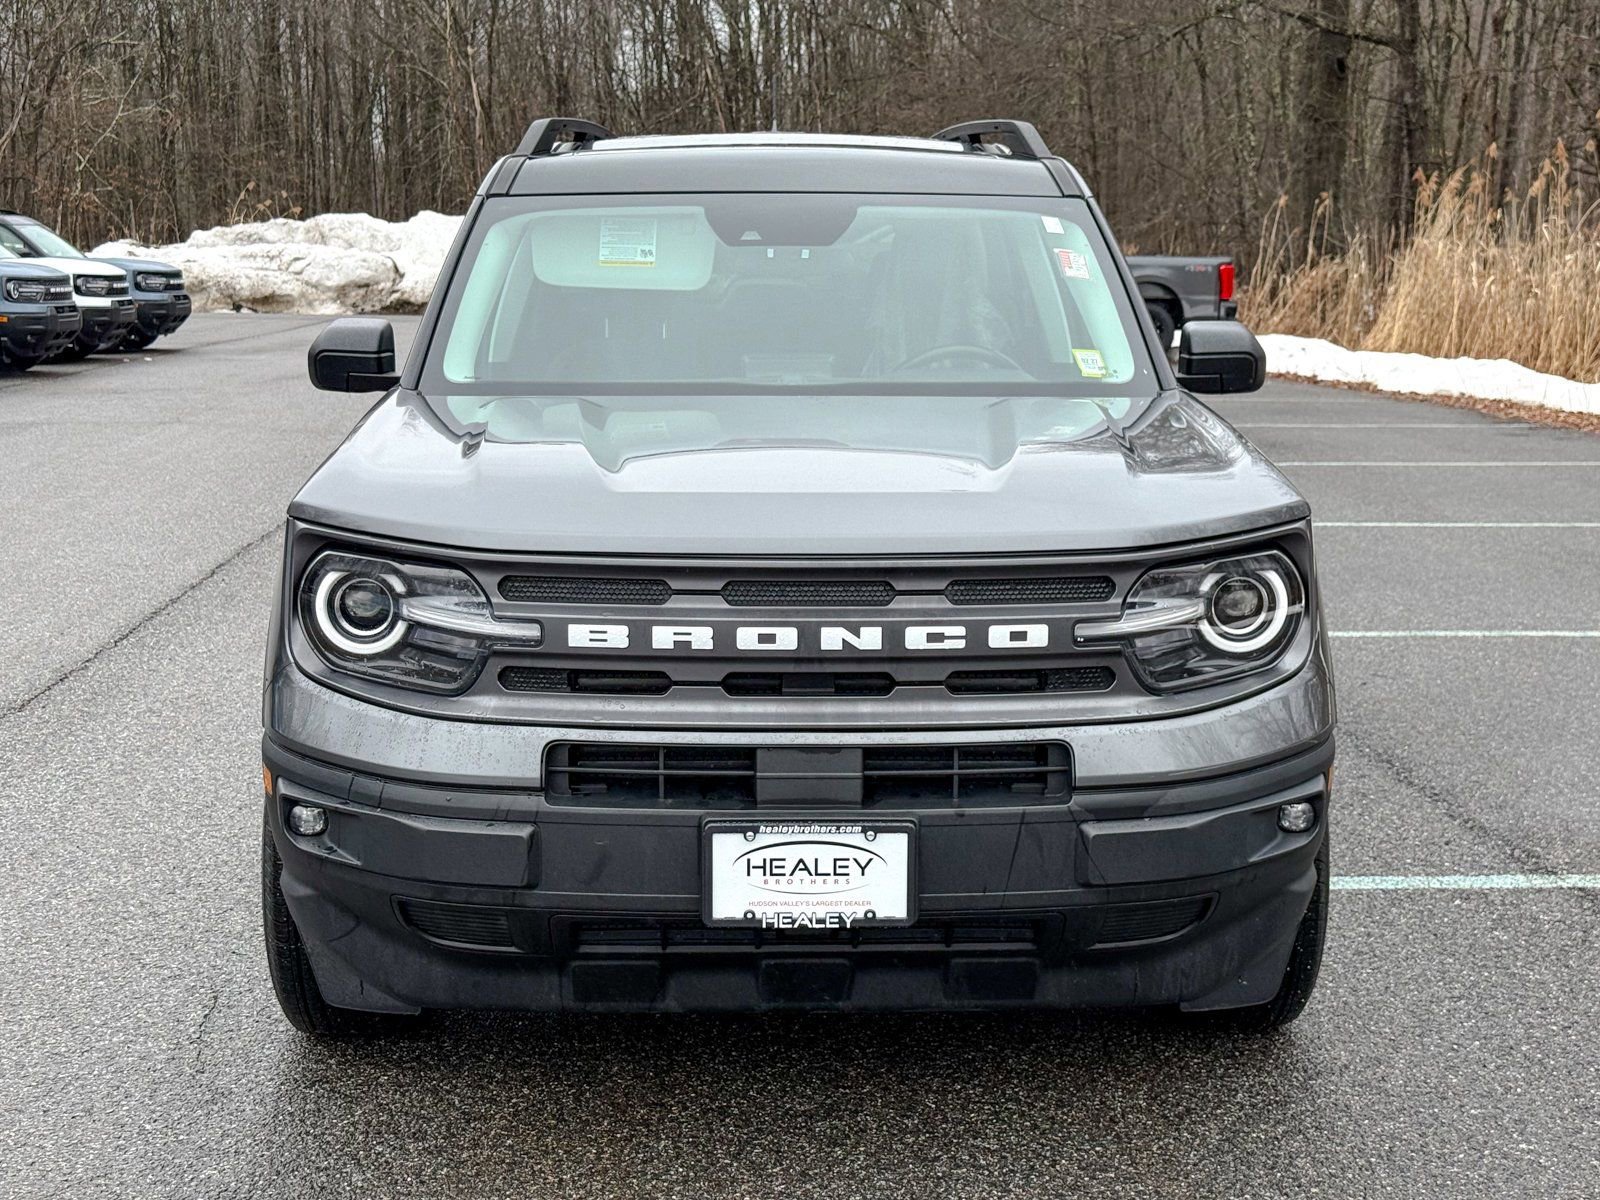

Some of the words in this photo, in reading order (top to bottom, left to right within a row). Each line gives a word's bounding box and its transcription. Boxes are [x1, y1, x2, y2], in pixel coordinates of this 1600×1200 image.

[567, 623, 1050, 651] BRONCO
[759, 825, 862, 834] healeybrothers.com
[746, 858, 874, 877] HEALEY
[762, 912, 857, 929] HEALEY
